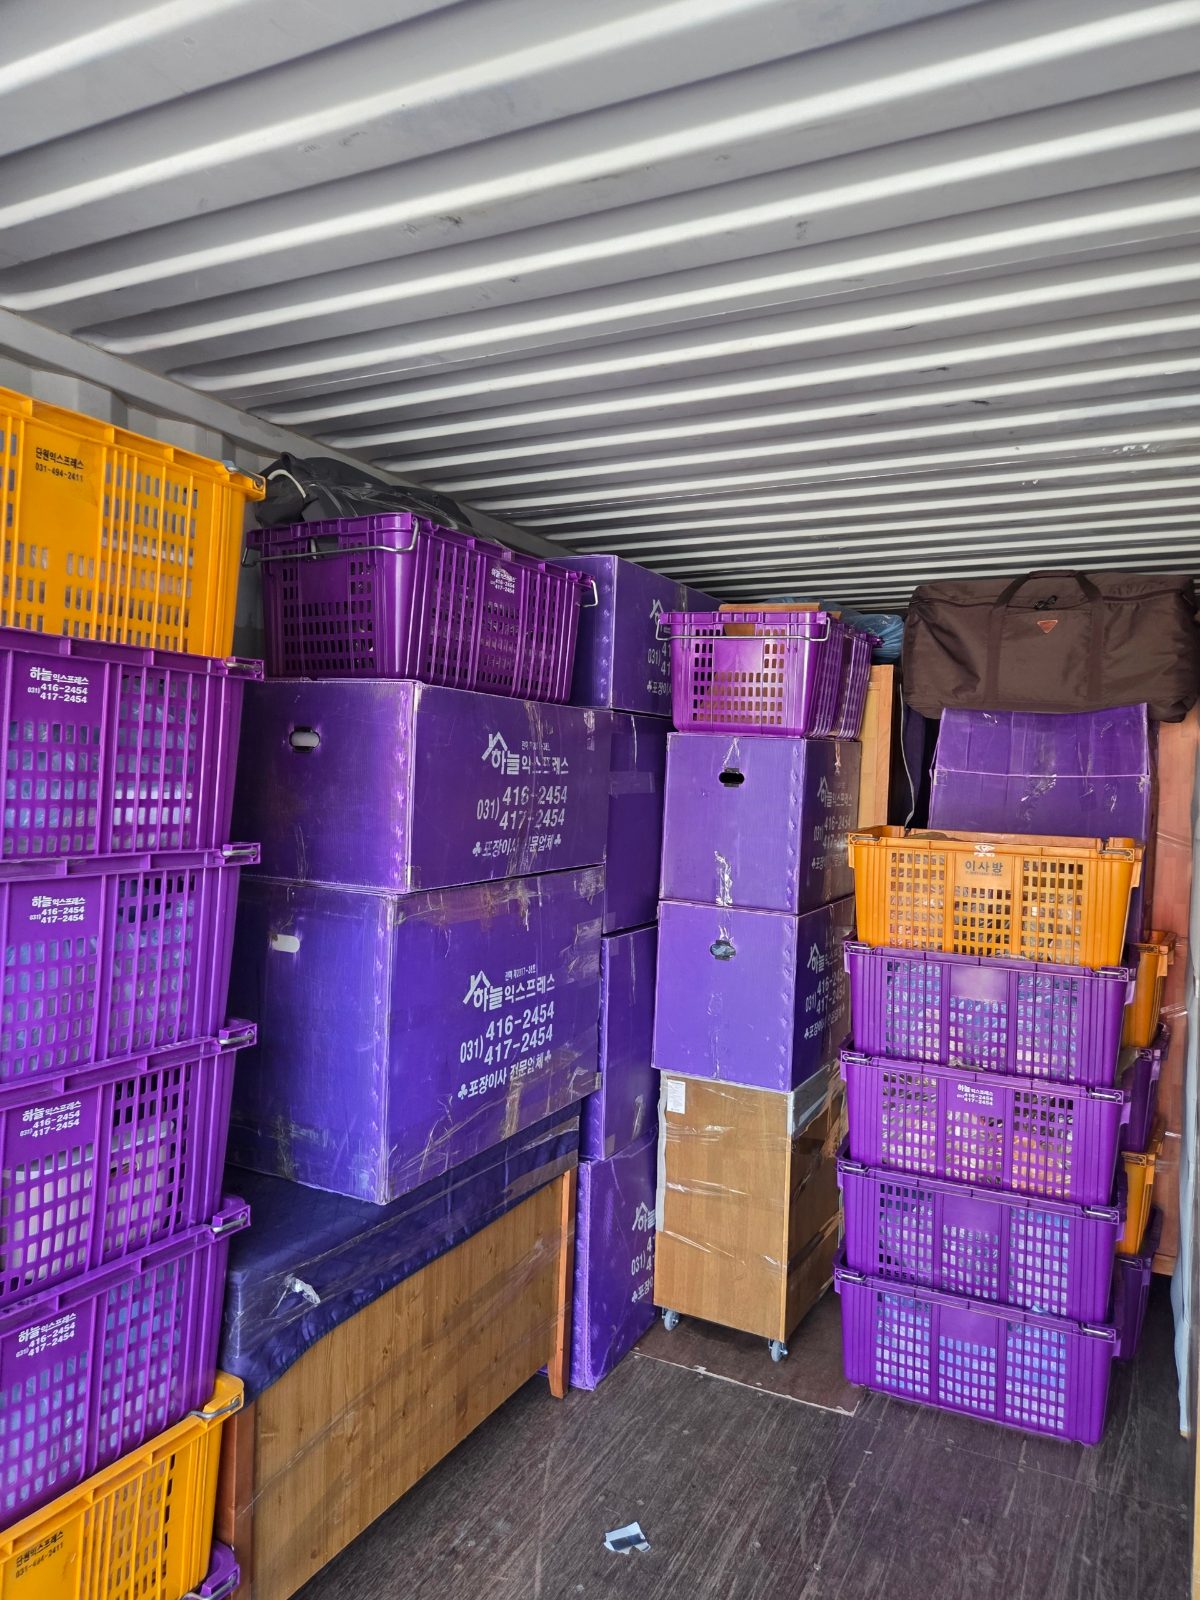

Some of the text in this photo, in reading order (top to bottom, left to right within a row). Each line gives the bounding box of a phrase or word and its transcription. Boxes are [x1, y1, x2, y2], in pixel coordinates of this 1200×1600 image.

[39, 692, 87, 704] 417-2454
[40, 683, 88, 695] 416-2454
[476, 785, 568, 820] 031) 416-2454
[40, 914, 84, 924] 417-2454
[41, 906, 85, 916] 416-2454
[473, 973, 555, 1013] 하늘익스프레스
[460, 1001, 555, 1063] 031) 416-2454
[484, 1023, 553, 1065] 417-2454
[467, 1052, 544, 1099] 포장이사 전문업체
[32, 1118, 80, 1138] 417-2454
[33, 1110, 80, 1129] 416-2454
[631, 1250, 646, 1276] 031)
[28, 1322, 76, 1348] 416-2454
[28, 1330, 75, 1356] 417-2454
